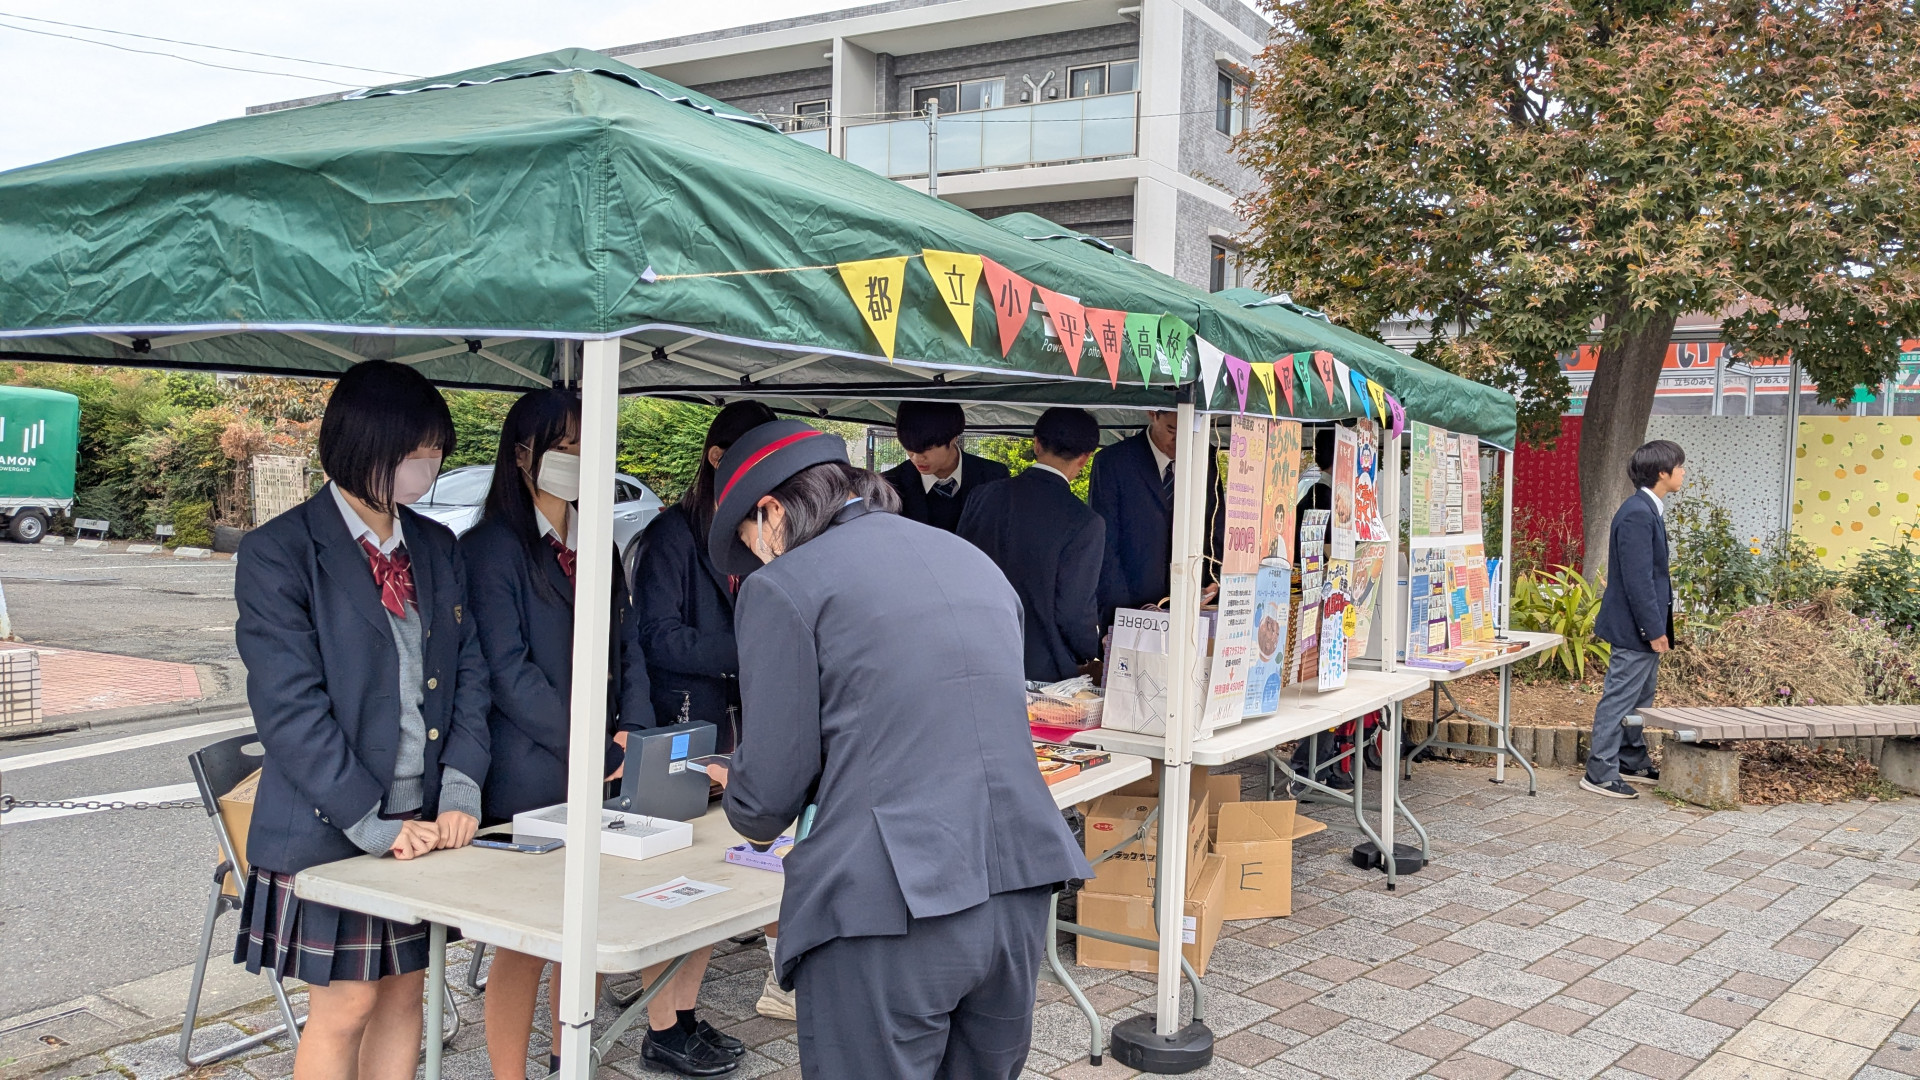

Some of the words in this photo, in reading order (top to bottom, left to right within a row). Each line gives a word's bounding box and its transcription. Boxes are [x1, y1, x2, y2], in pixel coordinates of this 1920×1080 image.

[1041, 338, 1065, 353] Powe
[1228, 526, 1255, 554] 700円
[1240, 862, 1263, 890] E
